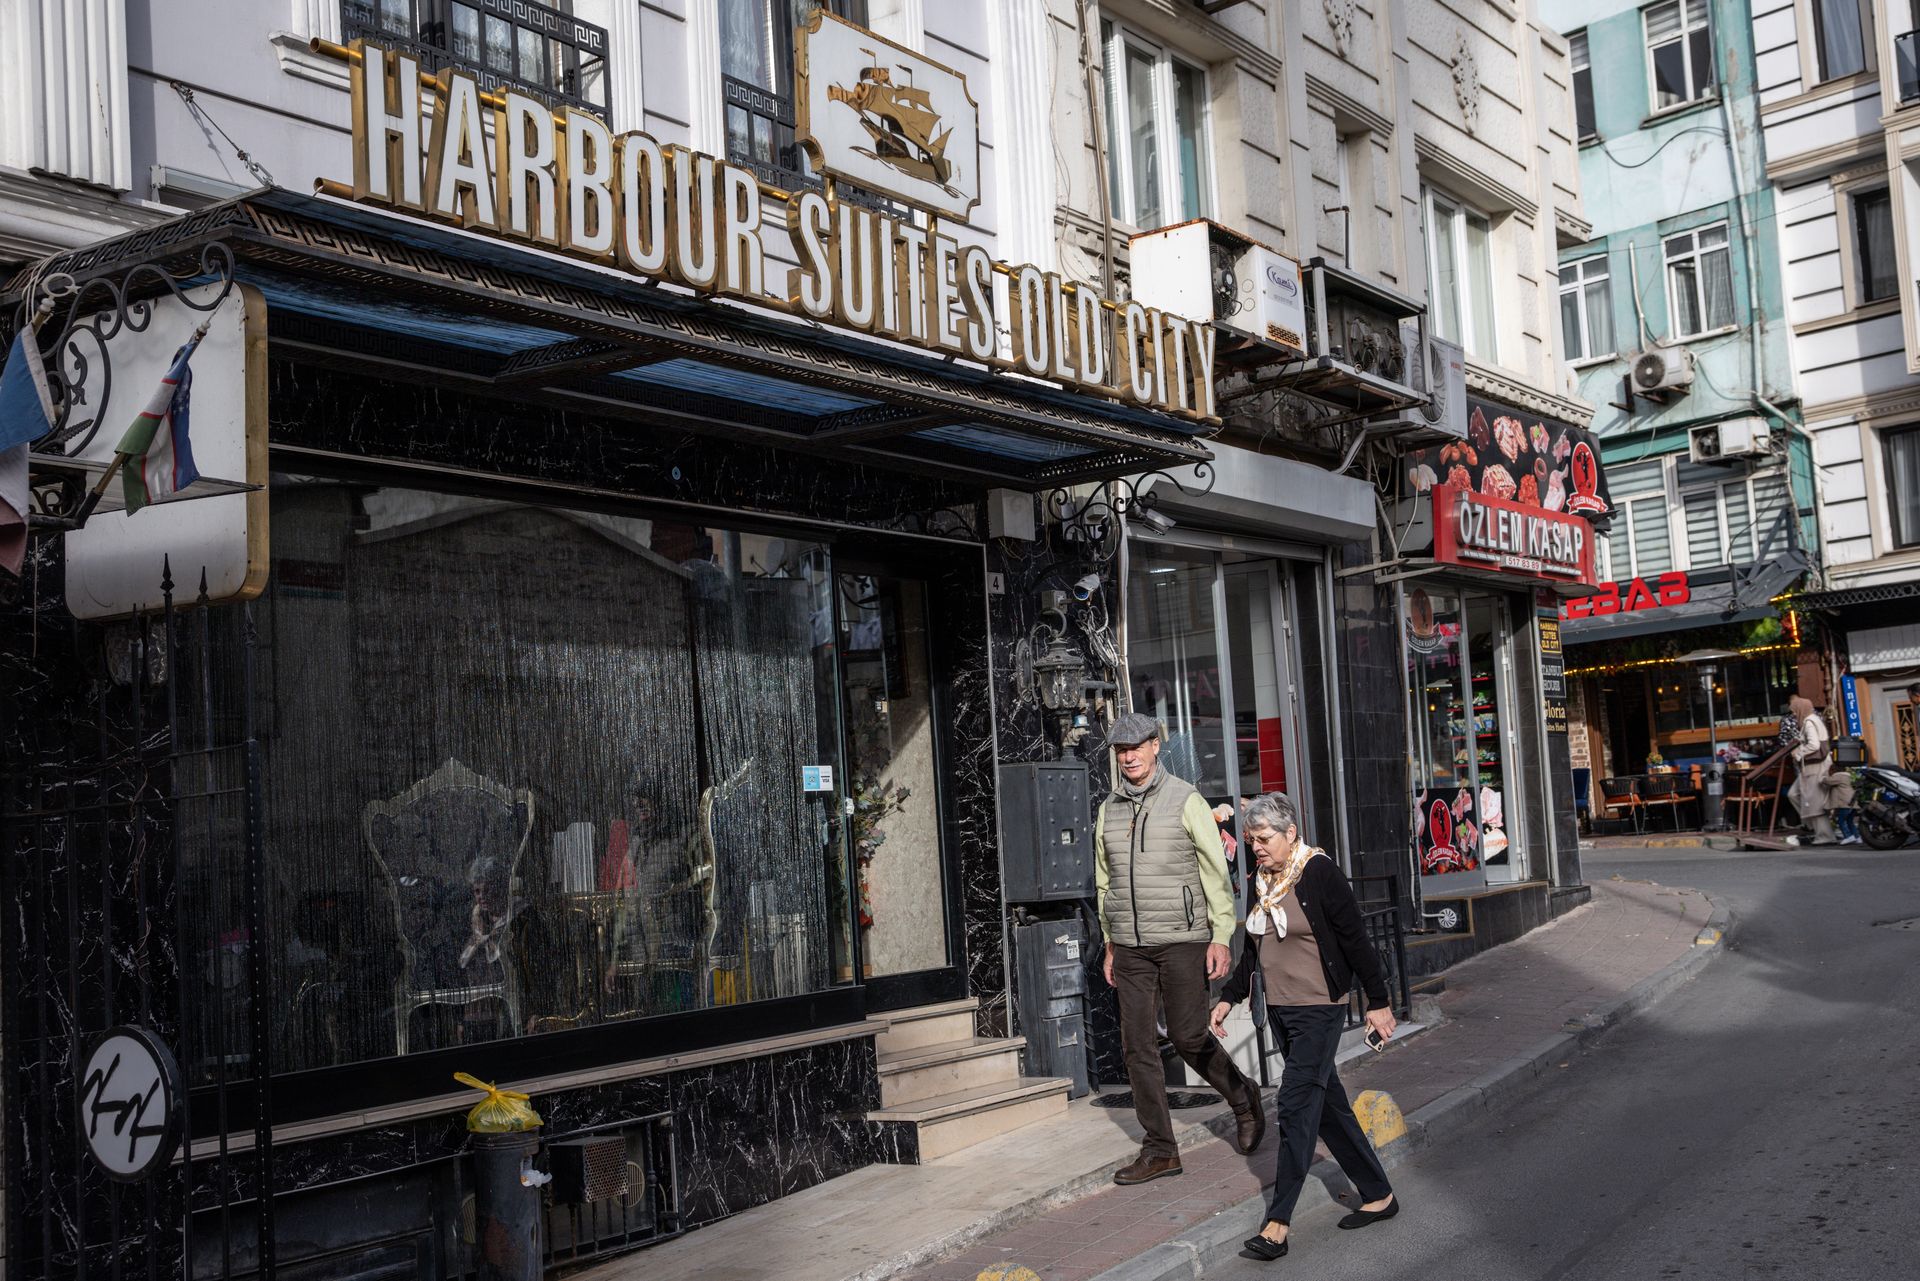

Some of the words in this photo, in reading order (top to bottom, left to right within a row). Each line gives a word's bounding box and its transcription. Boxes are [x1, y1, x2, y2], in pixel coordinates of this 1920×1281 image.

[350, 40, 765, 300] HARBOUR
[788, 190, 997, 360] SUITES
[1013, 263, 1105, 387] OLD
[1119, 300, 1217, 419] CITY
[1460, 491, 1523, 553] ÖZLEM
[1528, 515, 1583, 564] KASAP
[992, 575, 1000, 591] 4
[1508, 557, 1520, 567] 517
[1558, 571, 1691, 621] EBAB
